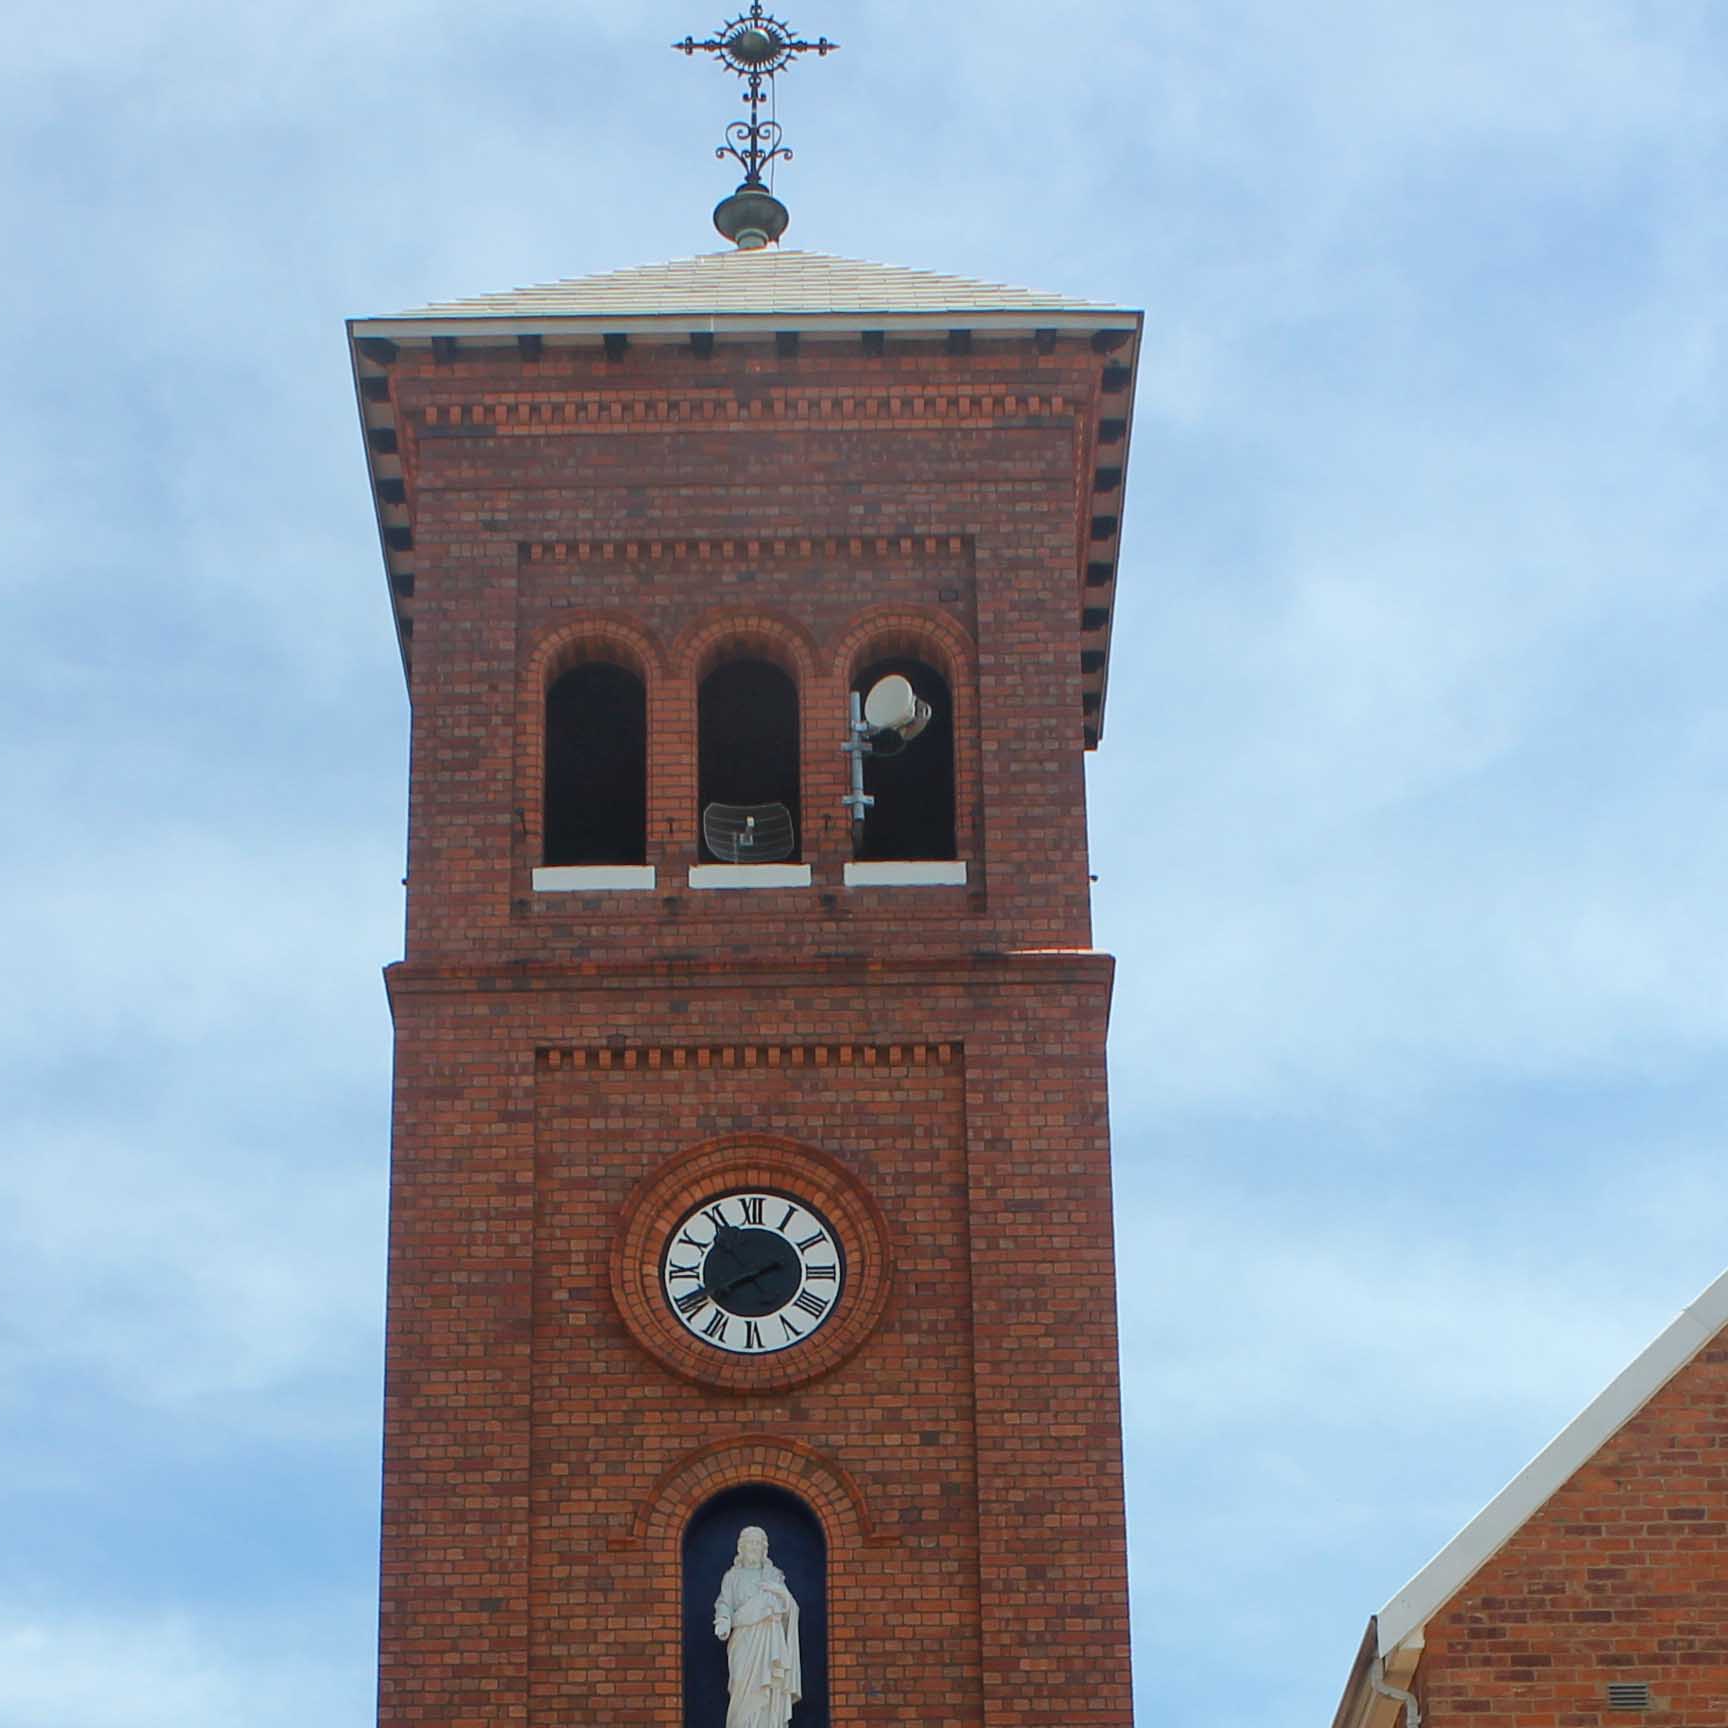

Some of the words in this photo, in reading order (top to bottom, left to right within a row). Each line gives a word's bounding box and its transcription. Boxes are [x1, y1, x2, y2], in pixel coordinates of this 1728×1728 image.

[701, 1203, 732, 1232] XI
[738, 1198, 766, 1225] XII
[777, 1205, 799, 1232] I
[678, 1228, 712, 1255] X
[795, 1229, 828, 1254] II
[669, 1259, 700, 1283] IX
[806, 1263, 836, 1283] III
[792, 1287, 831, 1320] IIII
[701, 1308, 731, 1343] VII
[744, 1320, 765, 1348] VI
[779, 1314, 804, 1342] V
